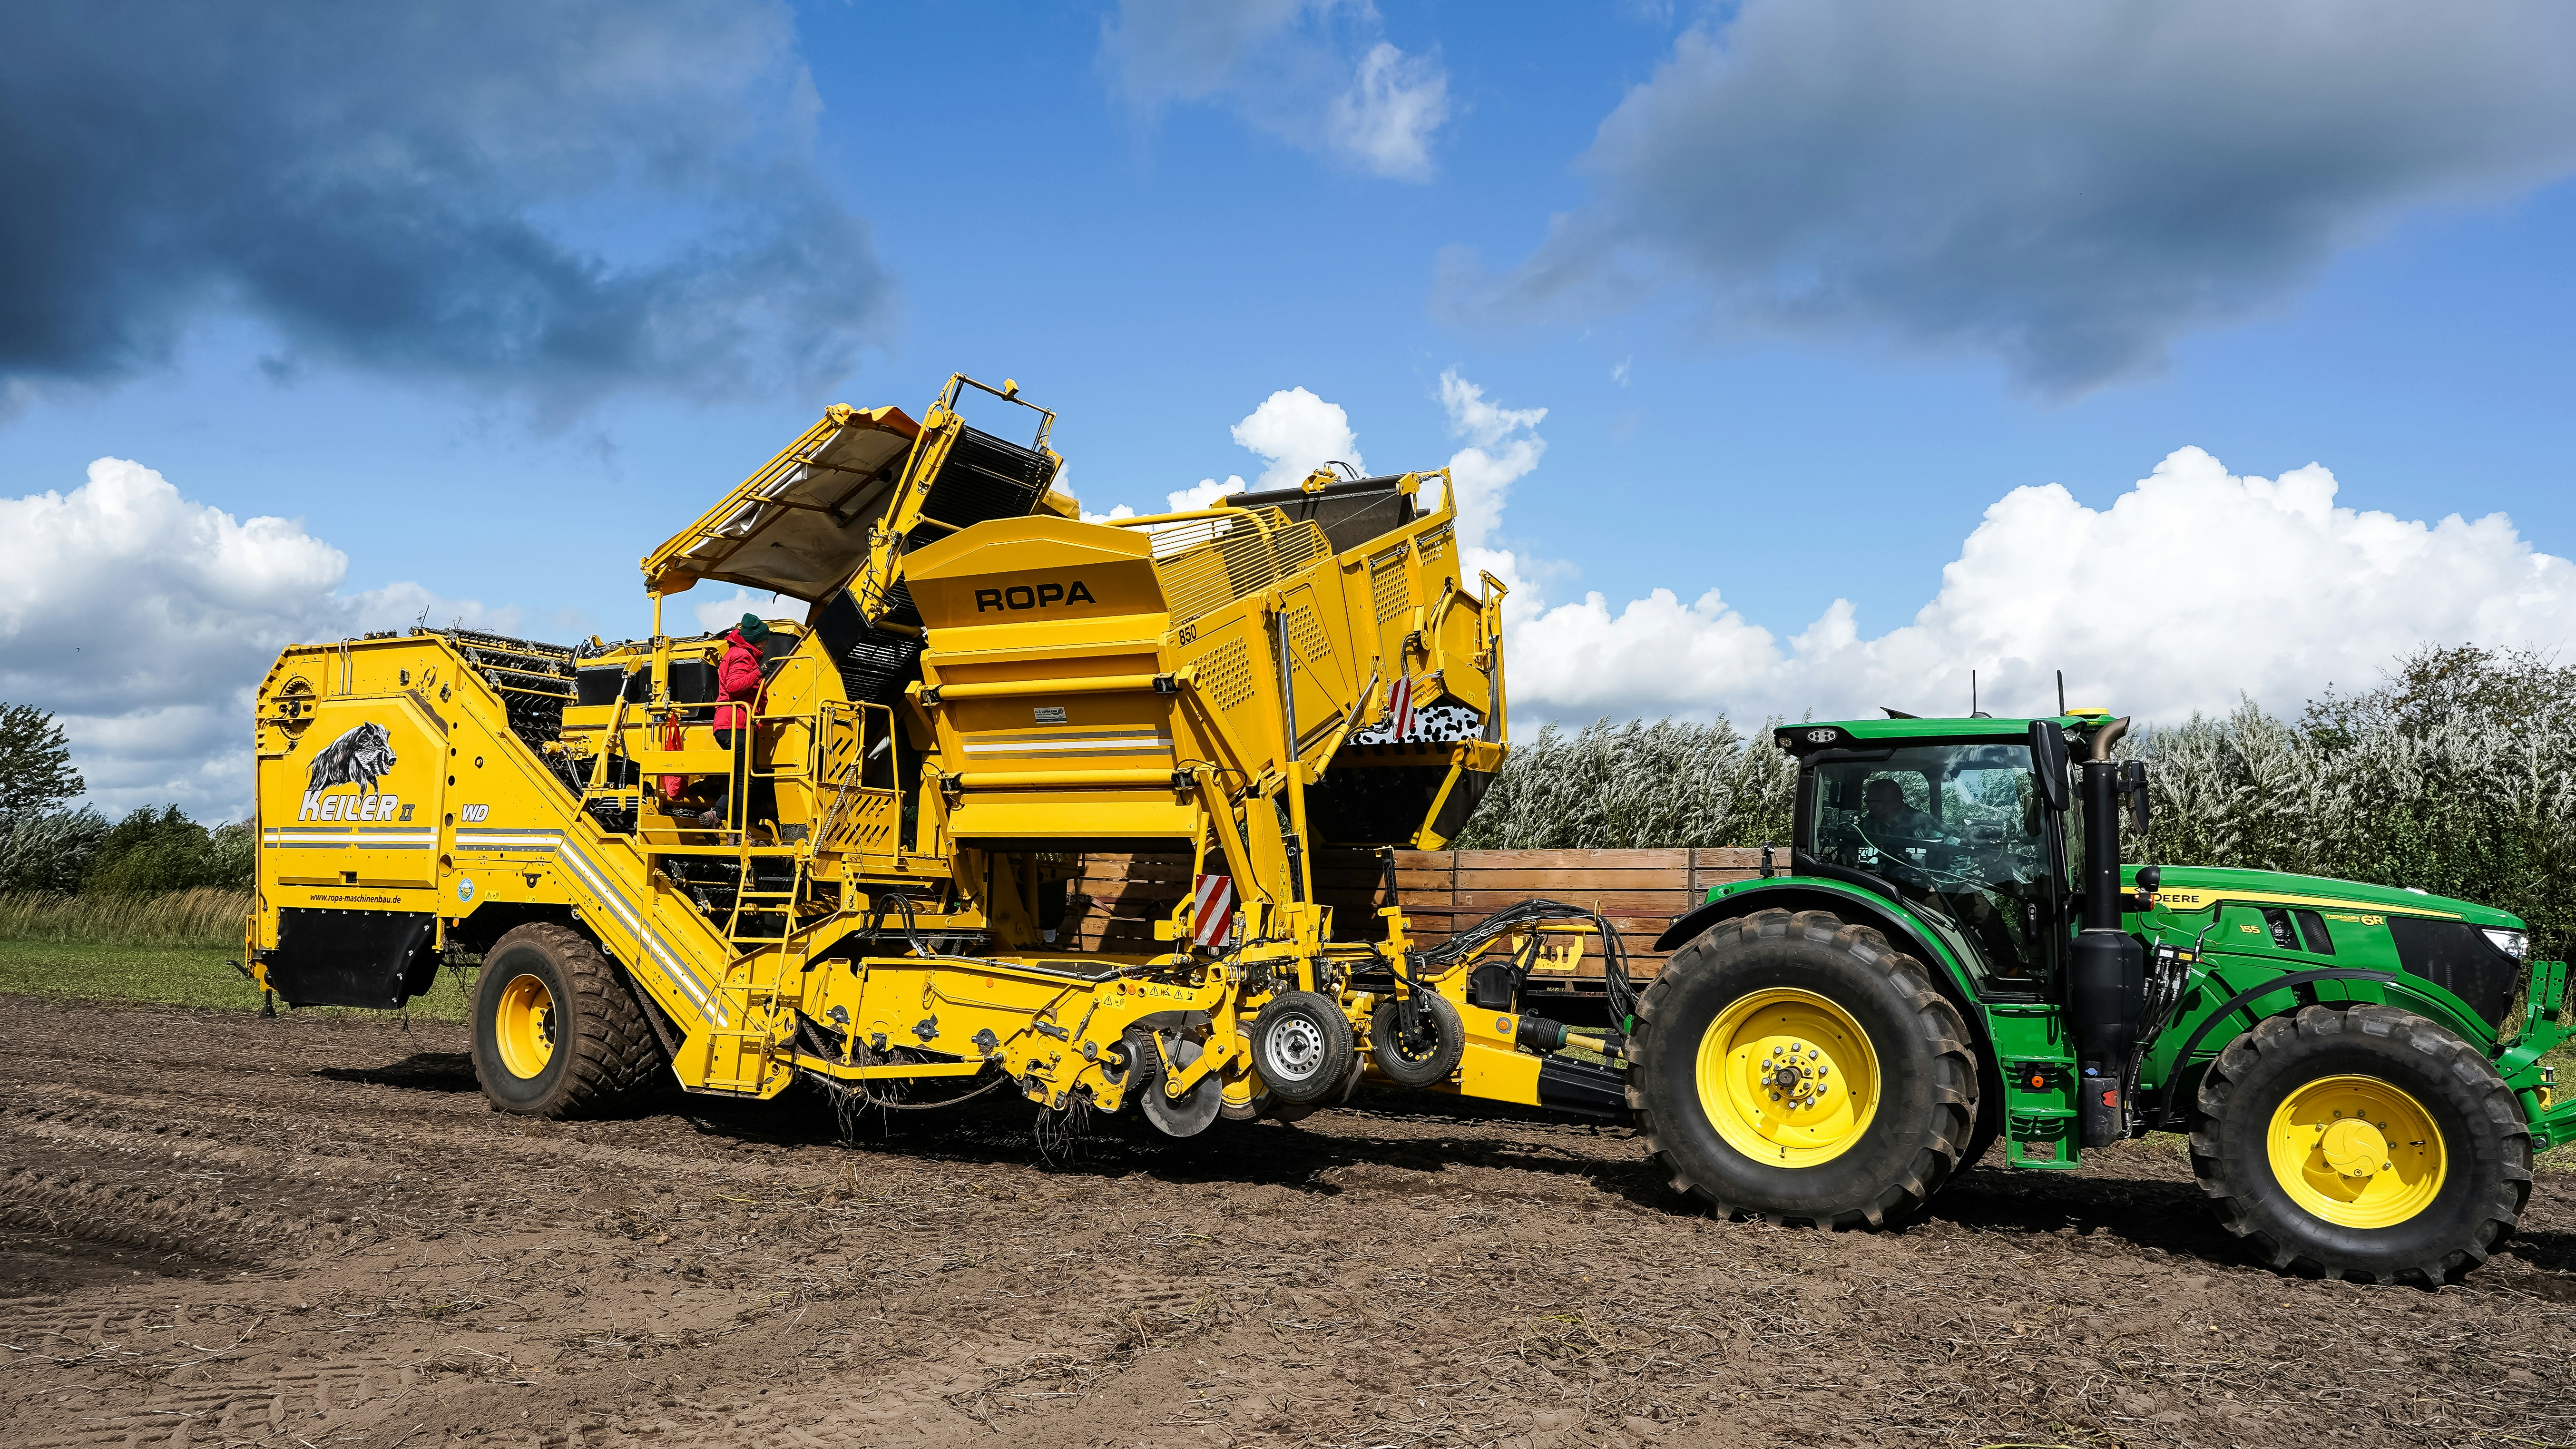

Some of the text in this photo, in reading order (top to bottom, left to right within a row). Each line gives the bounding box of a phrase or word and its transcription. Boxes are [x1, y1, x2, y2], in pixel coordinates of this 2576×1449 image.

[974, 581, 1097, 613] ROPA
[1179, 624, 1197, 646] 850
[298, 790, 415, 822] KEILER II
[461, 804, 489, 822] WD
[310, 894, 401, 903] www.ropa-maschinenbau.de
[2152, 893, 2199, 902] DEERE
[2360, 914, 2385, 926] 6R
[2239, 924, 2261, 934] 155
